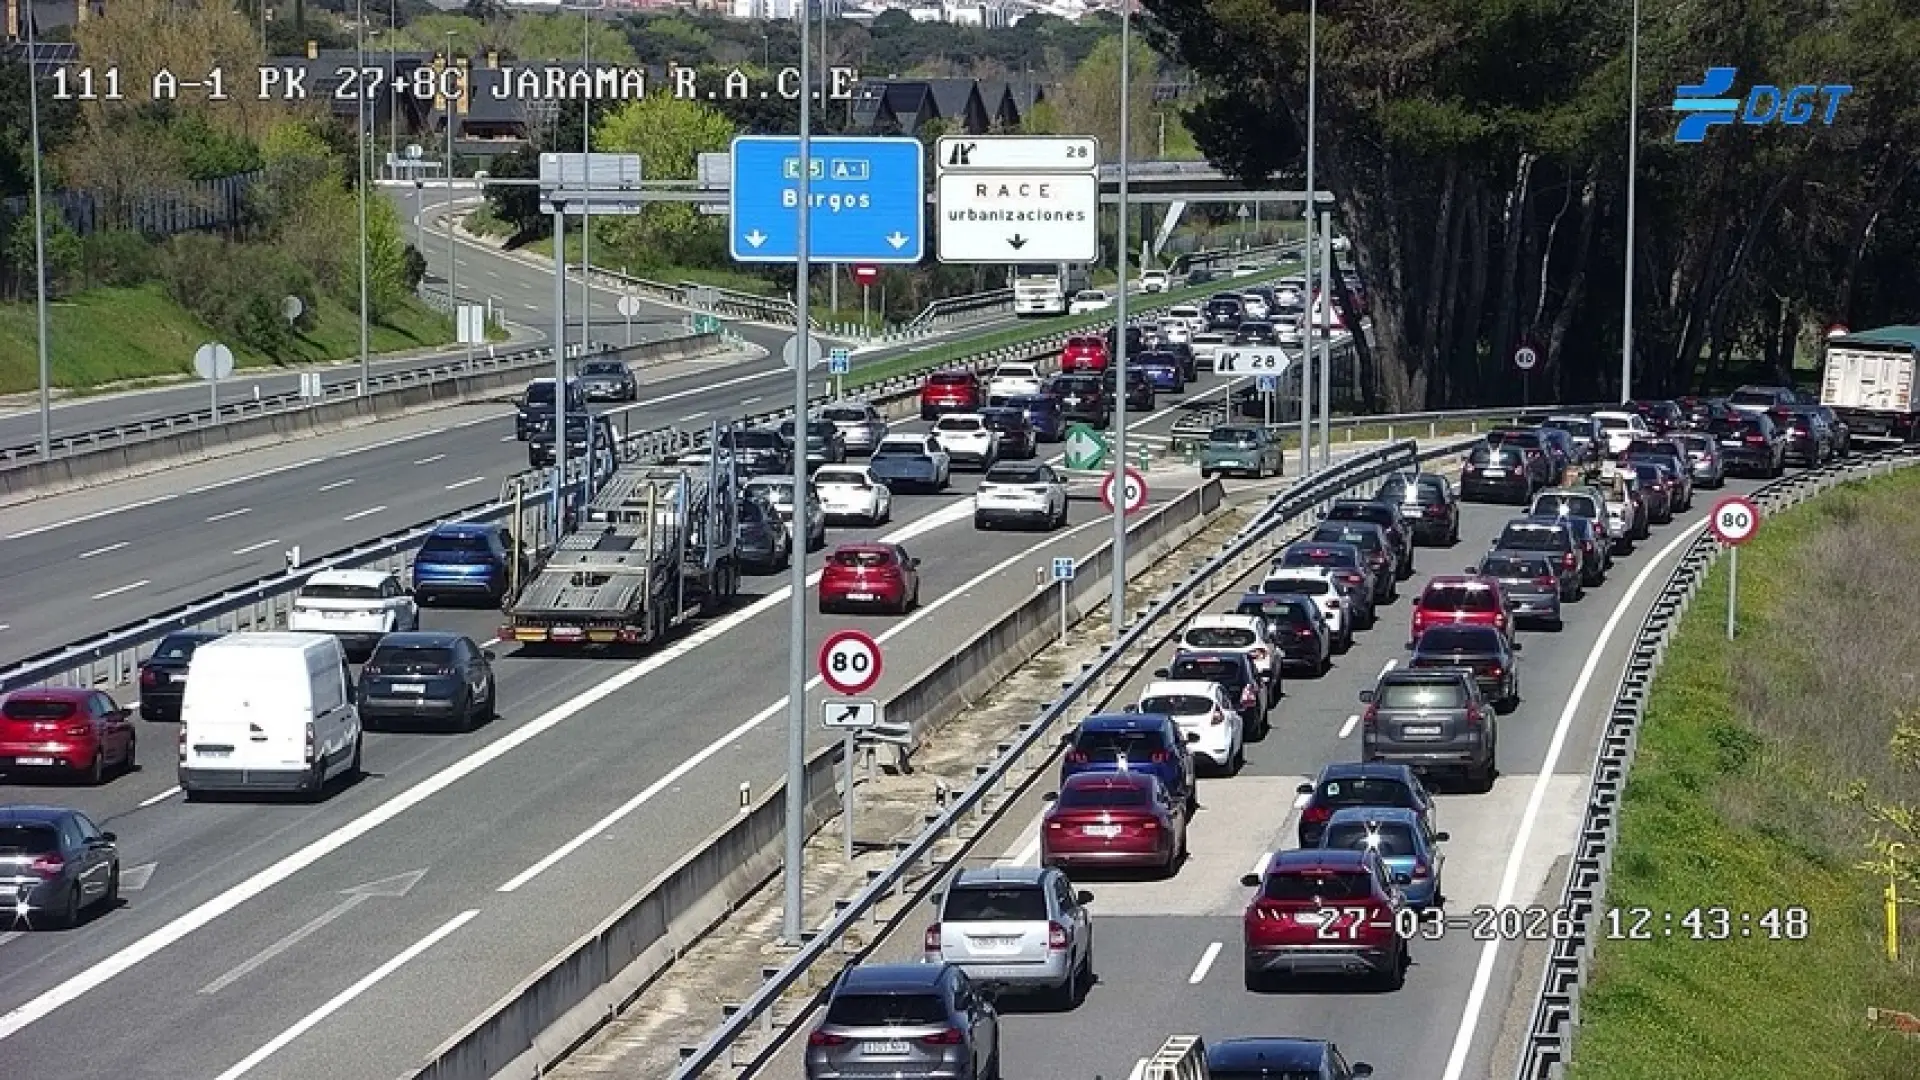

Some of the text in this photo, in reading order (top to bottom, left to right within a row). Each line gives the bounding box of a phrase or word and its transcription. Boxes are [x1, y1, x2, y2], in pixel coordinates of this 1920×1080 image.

[1066, 146, 1087, 158] 28
[789, 161, 820, 177] E5
[948, 208, 1086, 221] urbanizaciones
[1251, 354, 1276, 369] 28
[1722, 512, 1748, 528] 80
[832, 651, 869, 673] 80
